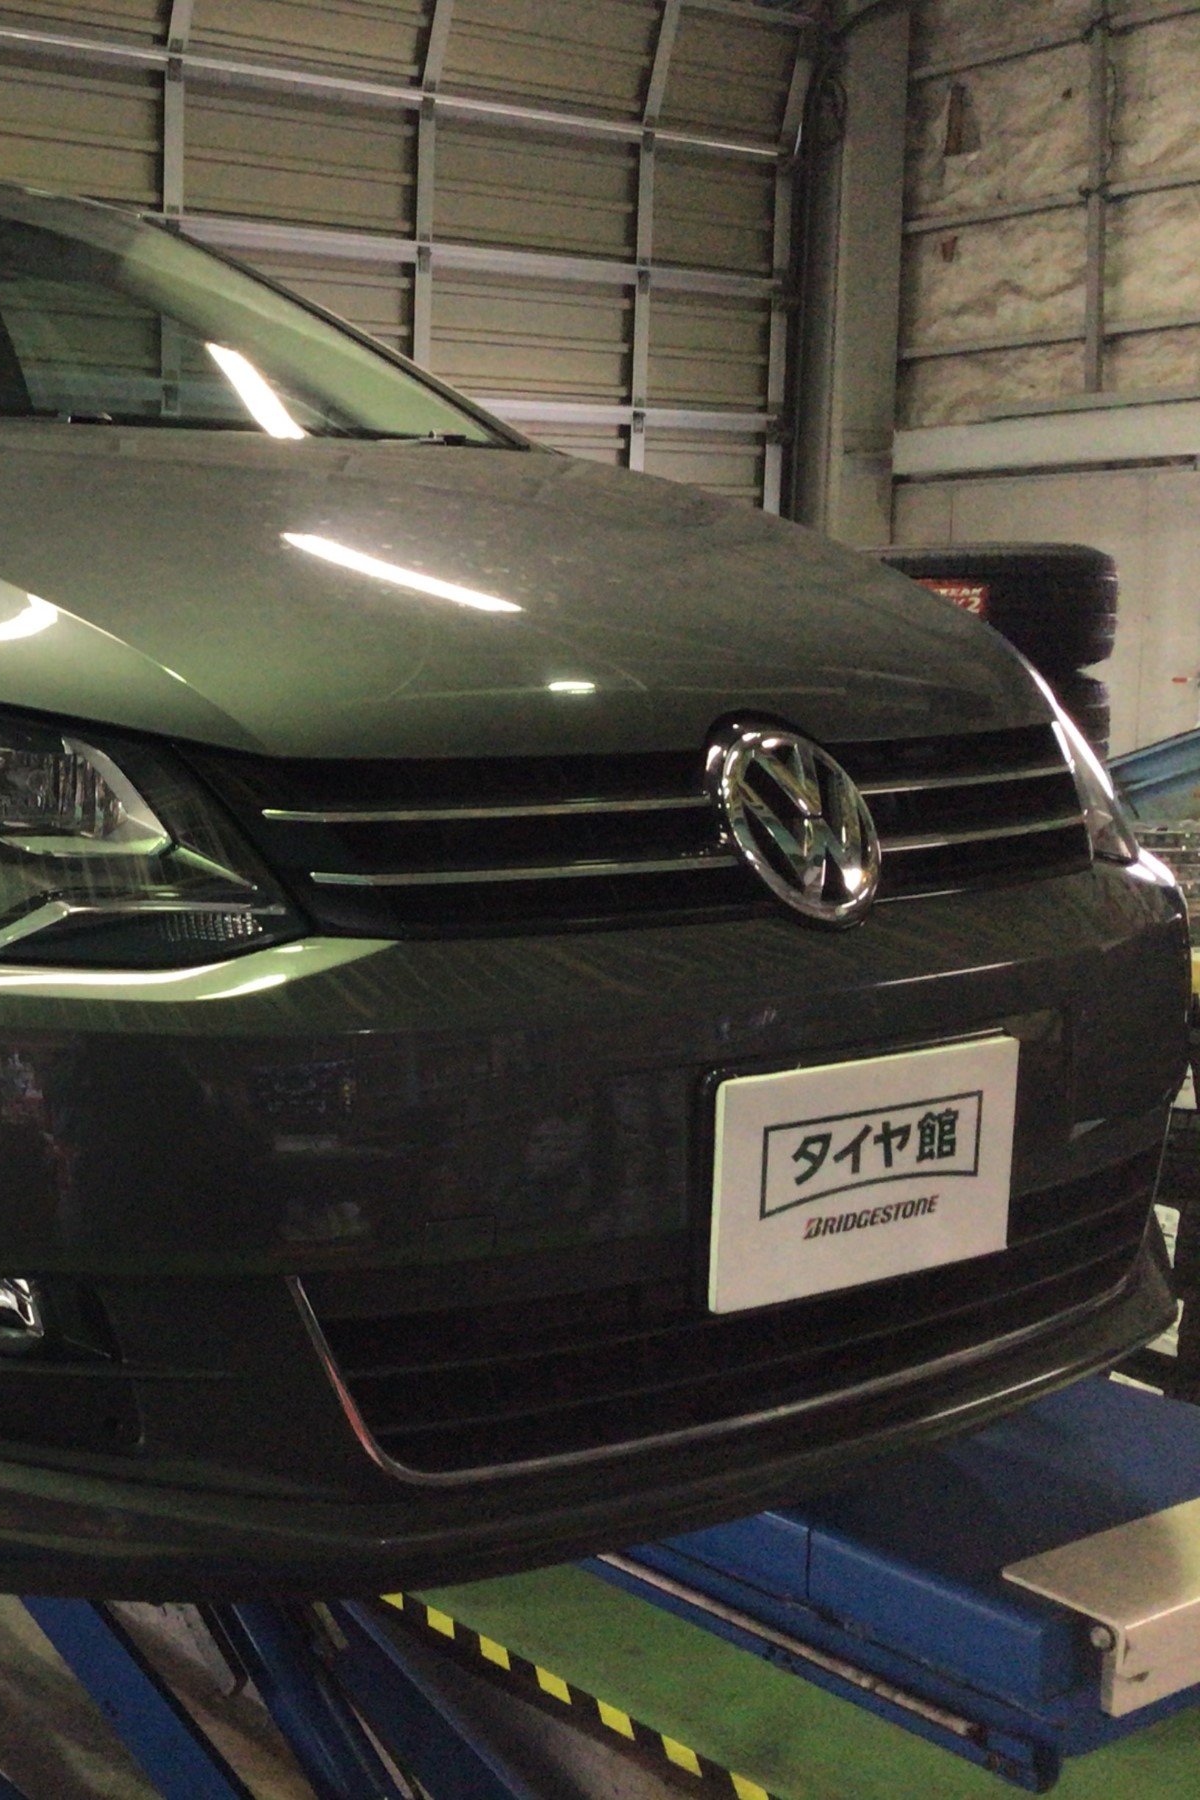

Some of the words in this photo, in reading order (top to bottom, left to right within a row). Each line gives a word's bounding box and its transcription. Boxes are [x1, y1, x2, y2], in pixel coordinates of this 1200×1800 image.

[791, 1107, 960, 1186] タイヤ館
[803, 1194, 940, 1241] BRIDGESTONE
